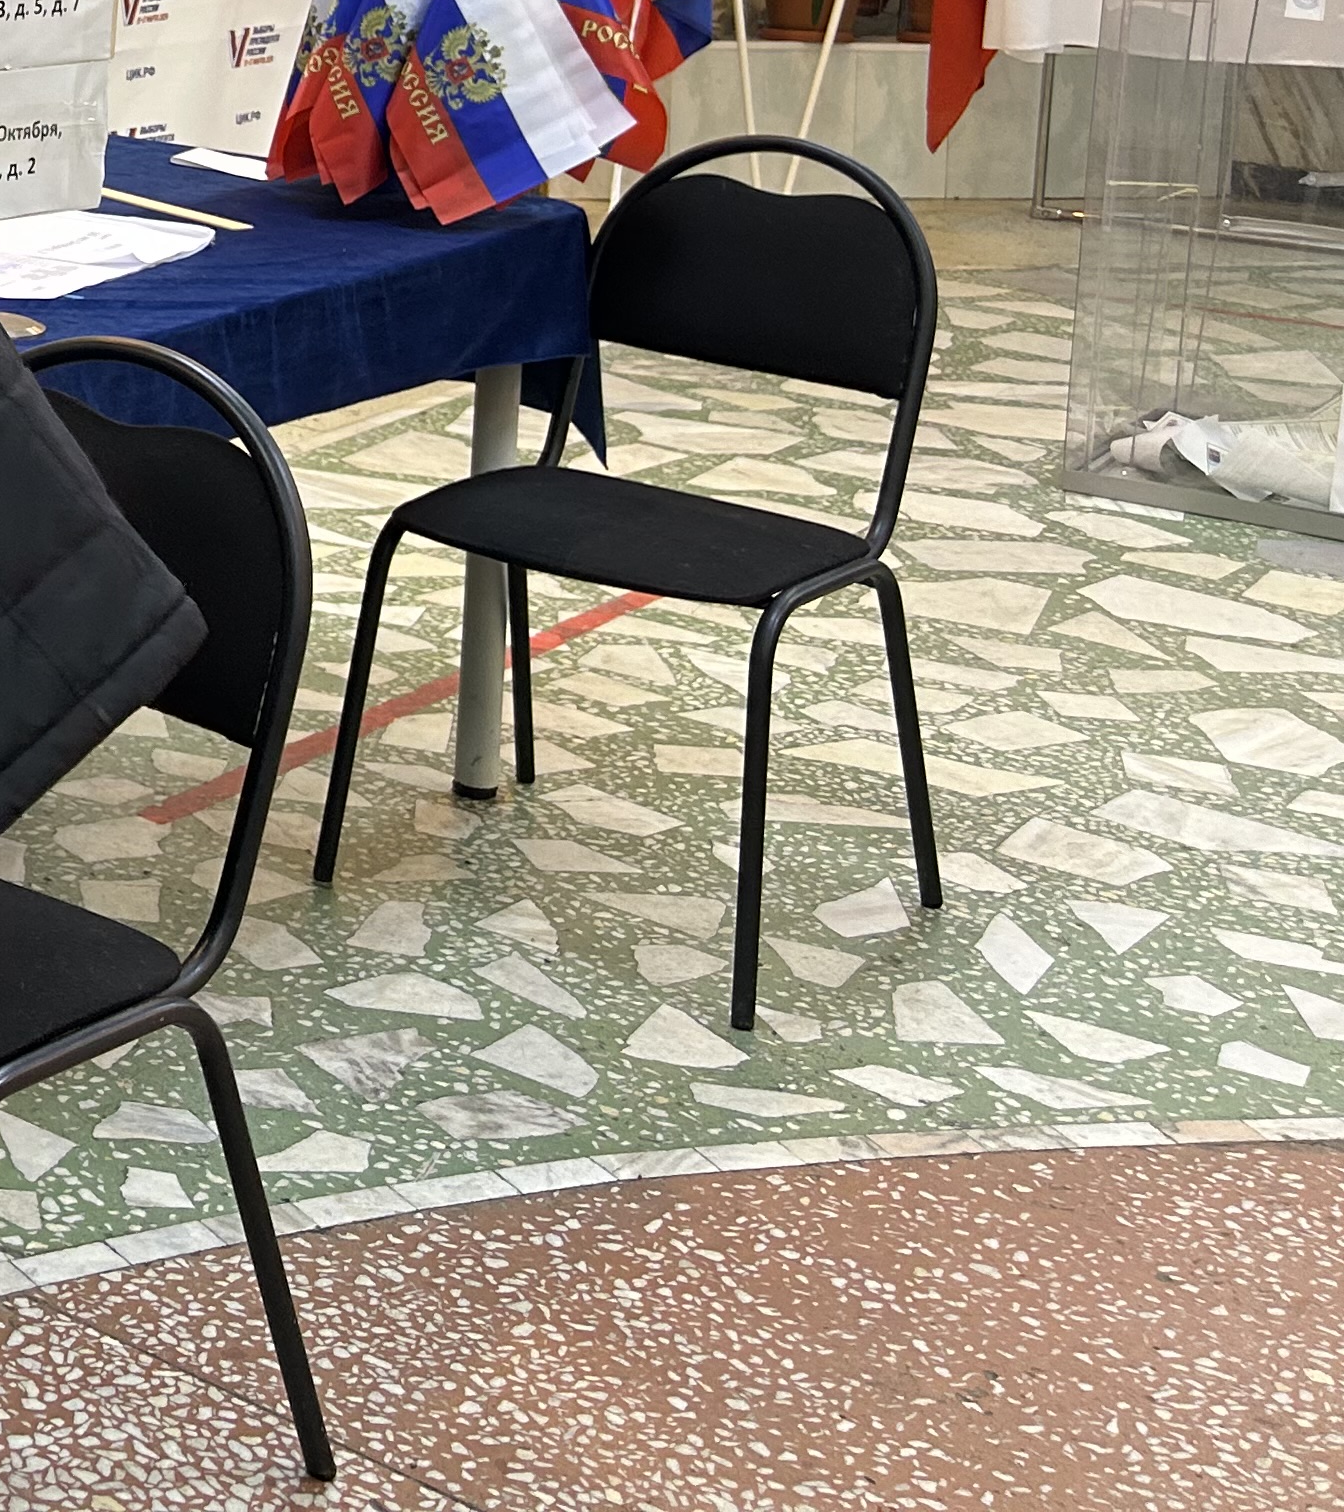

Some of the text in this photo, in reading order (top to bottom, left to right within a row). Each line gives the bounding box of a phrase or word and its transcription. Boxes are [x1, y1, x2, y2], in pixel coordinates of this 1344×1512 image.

[14, 2, 30, 21] д.
[51, 0, 67, 19] д.
[401, 61, 449, 145] ОССИЯ
[7, 163, 23, 181] д.
[27, 158, 36, 175] 2
